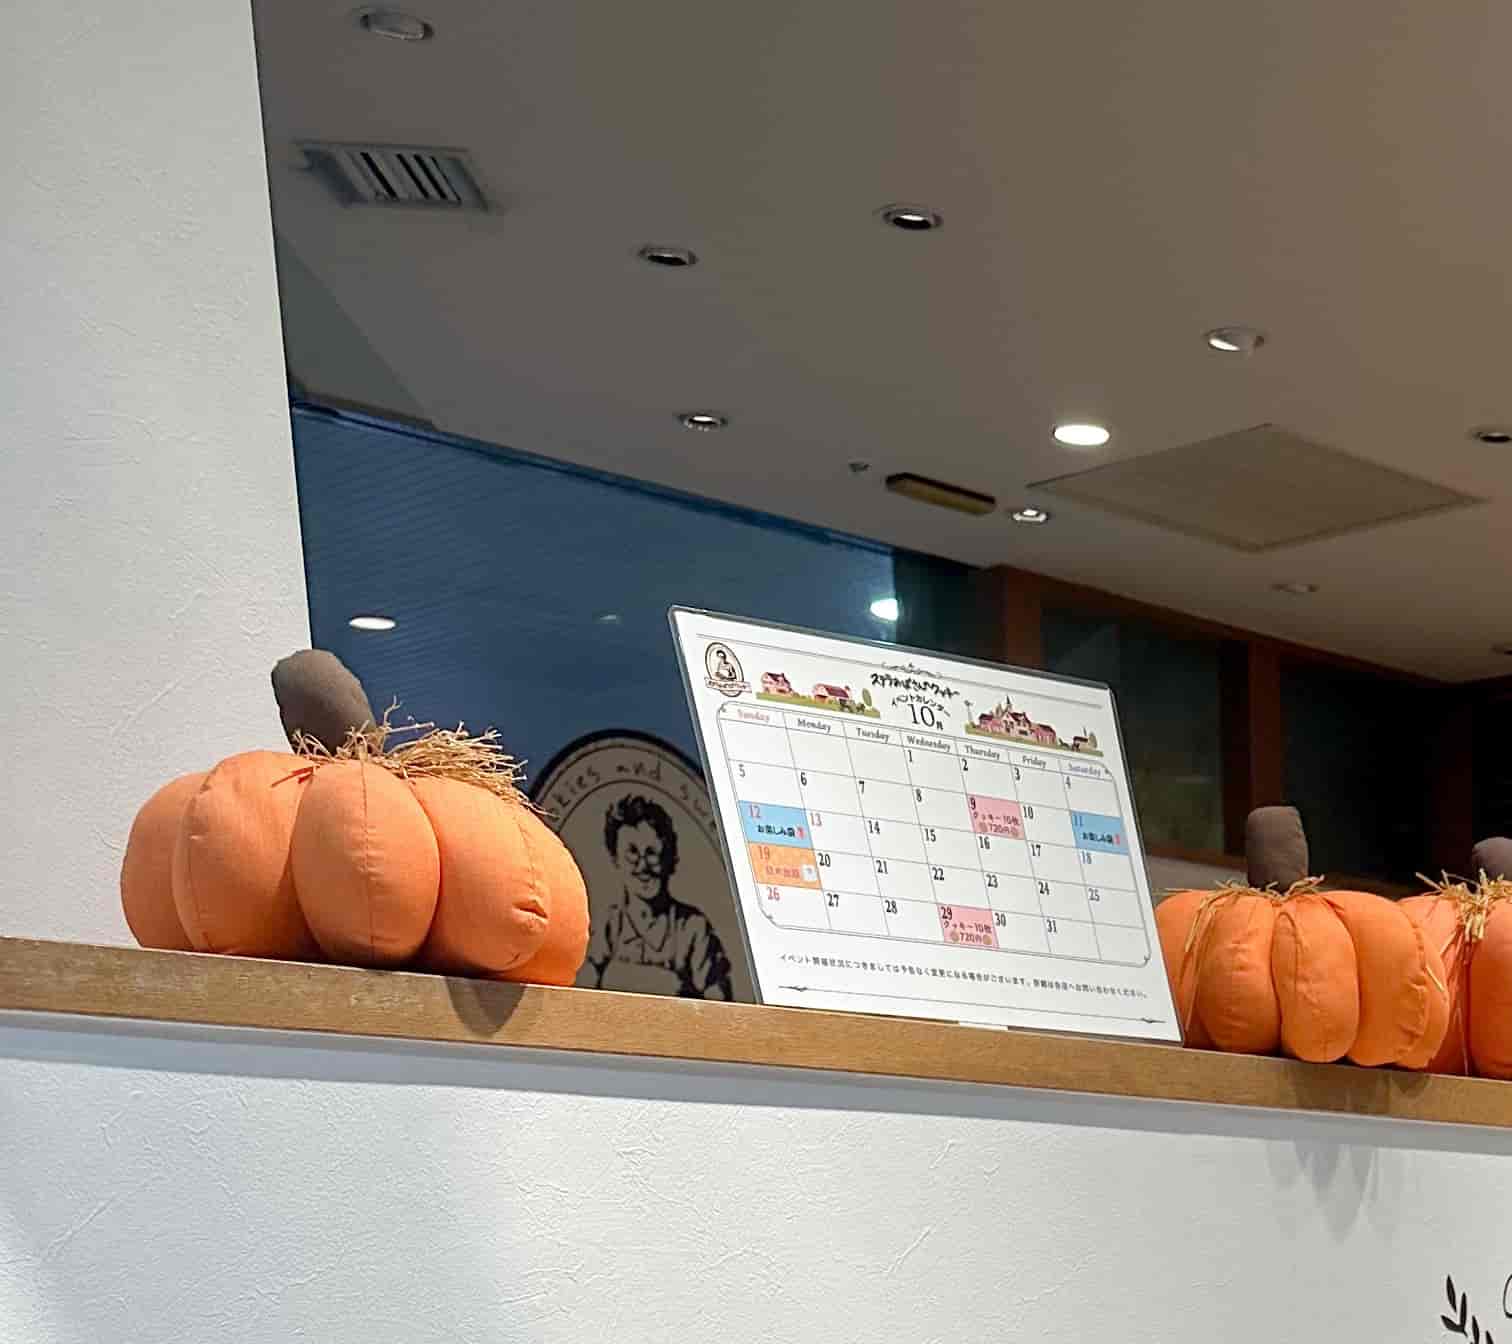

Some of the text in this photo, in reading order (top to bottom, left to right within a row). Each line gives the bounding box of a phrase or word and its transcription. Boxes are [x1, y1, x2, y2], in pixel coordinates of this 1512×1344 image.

[616, 759, 662, 781] and
[737, 708, 1101, 777] Sunday Monday Tuesday Wednesday Thursday Friday Saturday
[908, 751, 1071, 788] 1 2 3 4
[738, 765, 1083, 826] 5 6 7 8 9 10 11
[748, 805, 1091, 864] 12 13 14 15 16 17 18
[758, 846, 1100, 901] 19 20 21 22 23 24 25
[767, 887, 1057, 933] 26 27 28 29 30 31
